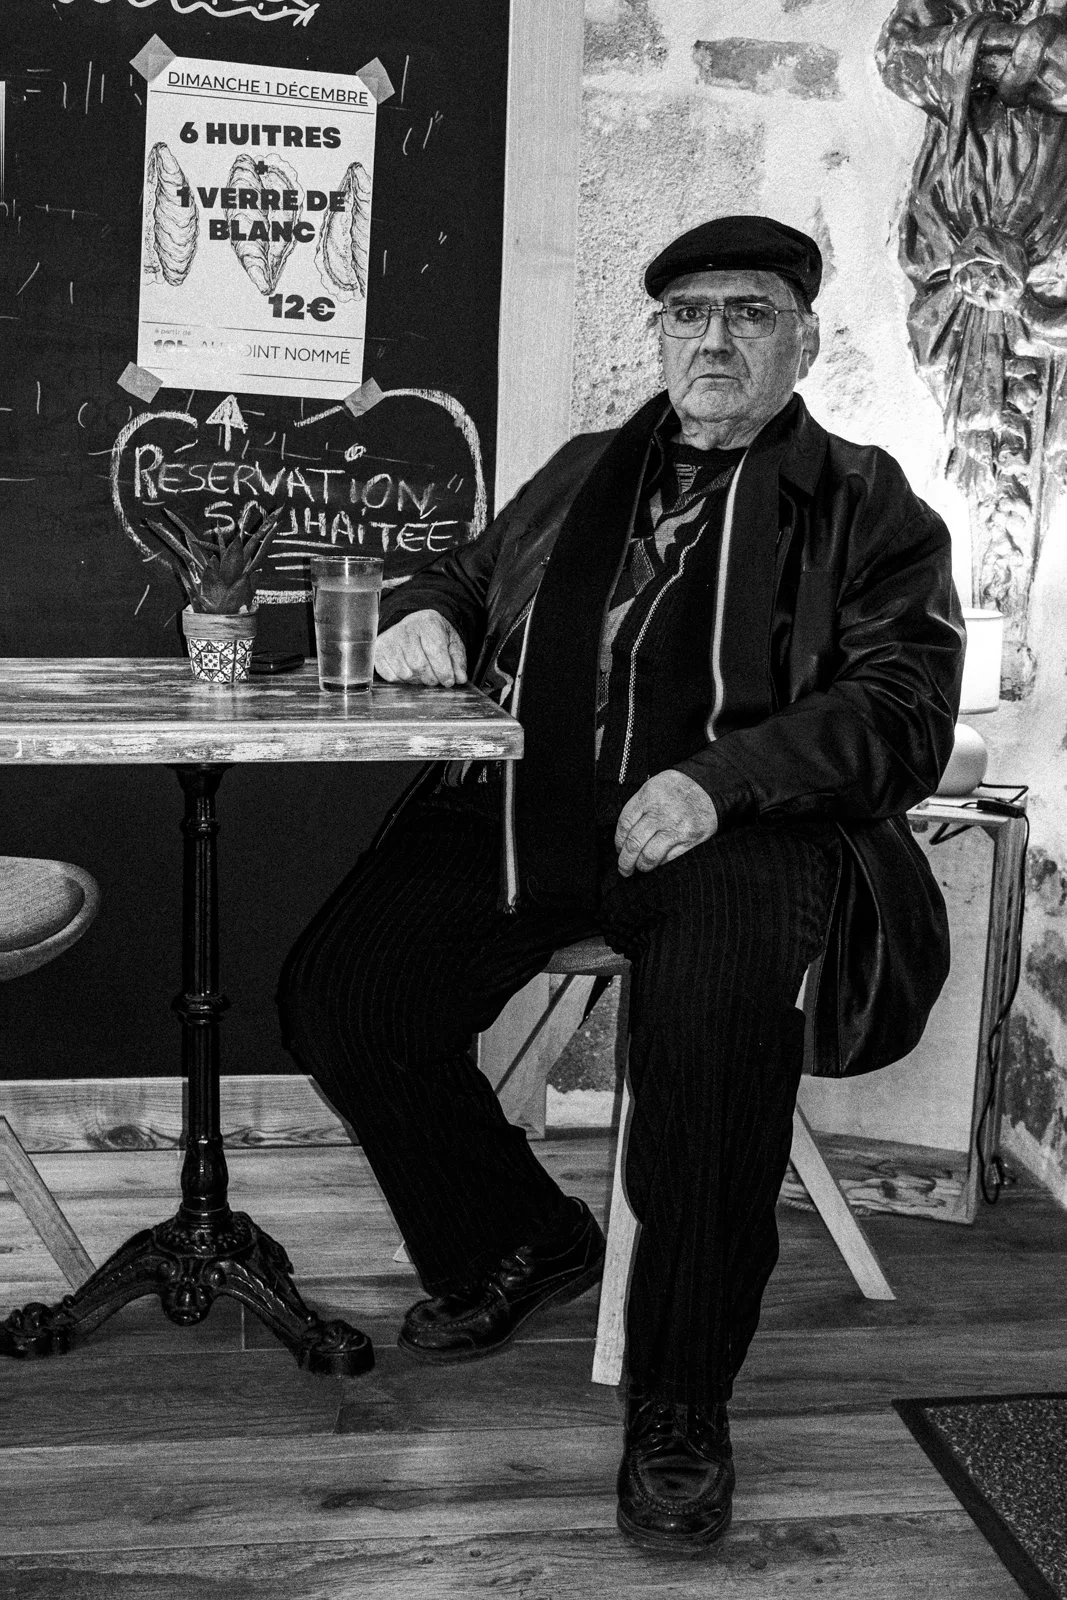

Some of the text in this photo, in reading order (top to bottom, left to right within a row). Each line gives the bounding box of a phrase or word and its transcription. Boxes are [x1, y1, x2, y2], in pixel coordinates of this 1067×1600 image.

[168, 71, 369, 105] DIMANCHE 1 DÉCEMBRE
[179, 122, 342, 149] 6 HUITRES
[176, 186, 347, 212] 1 VERRE DE
[209, 219, 316, 243] BLANC
[268, 293, 336, 322] 12€
[284, 348, 351, 365] NOMMÉ
